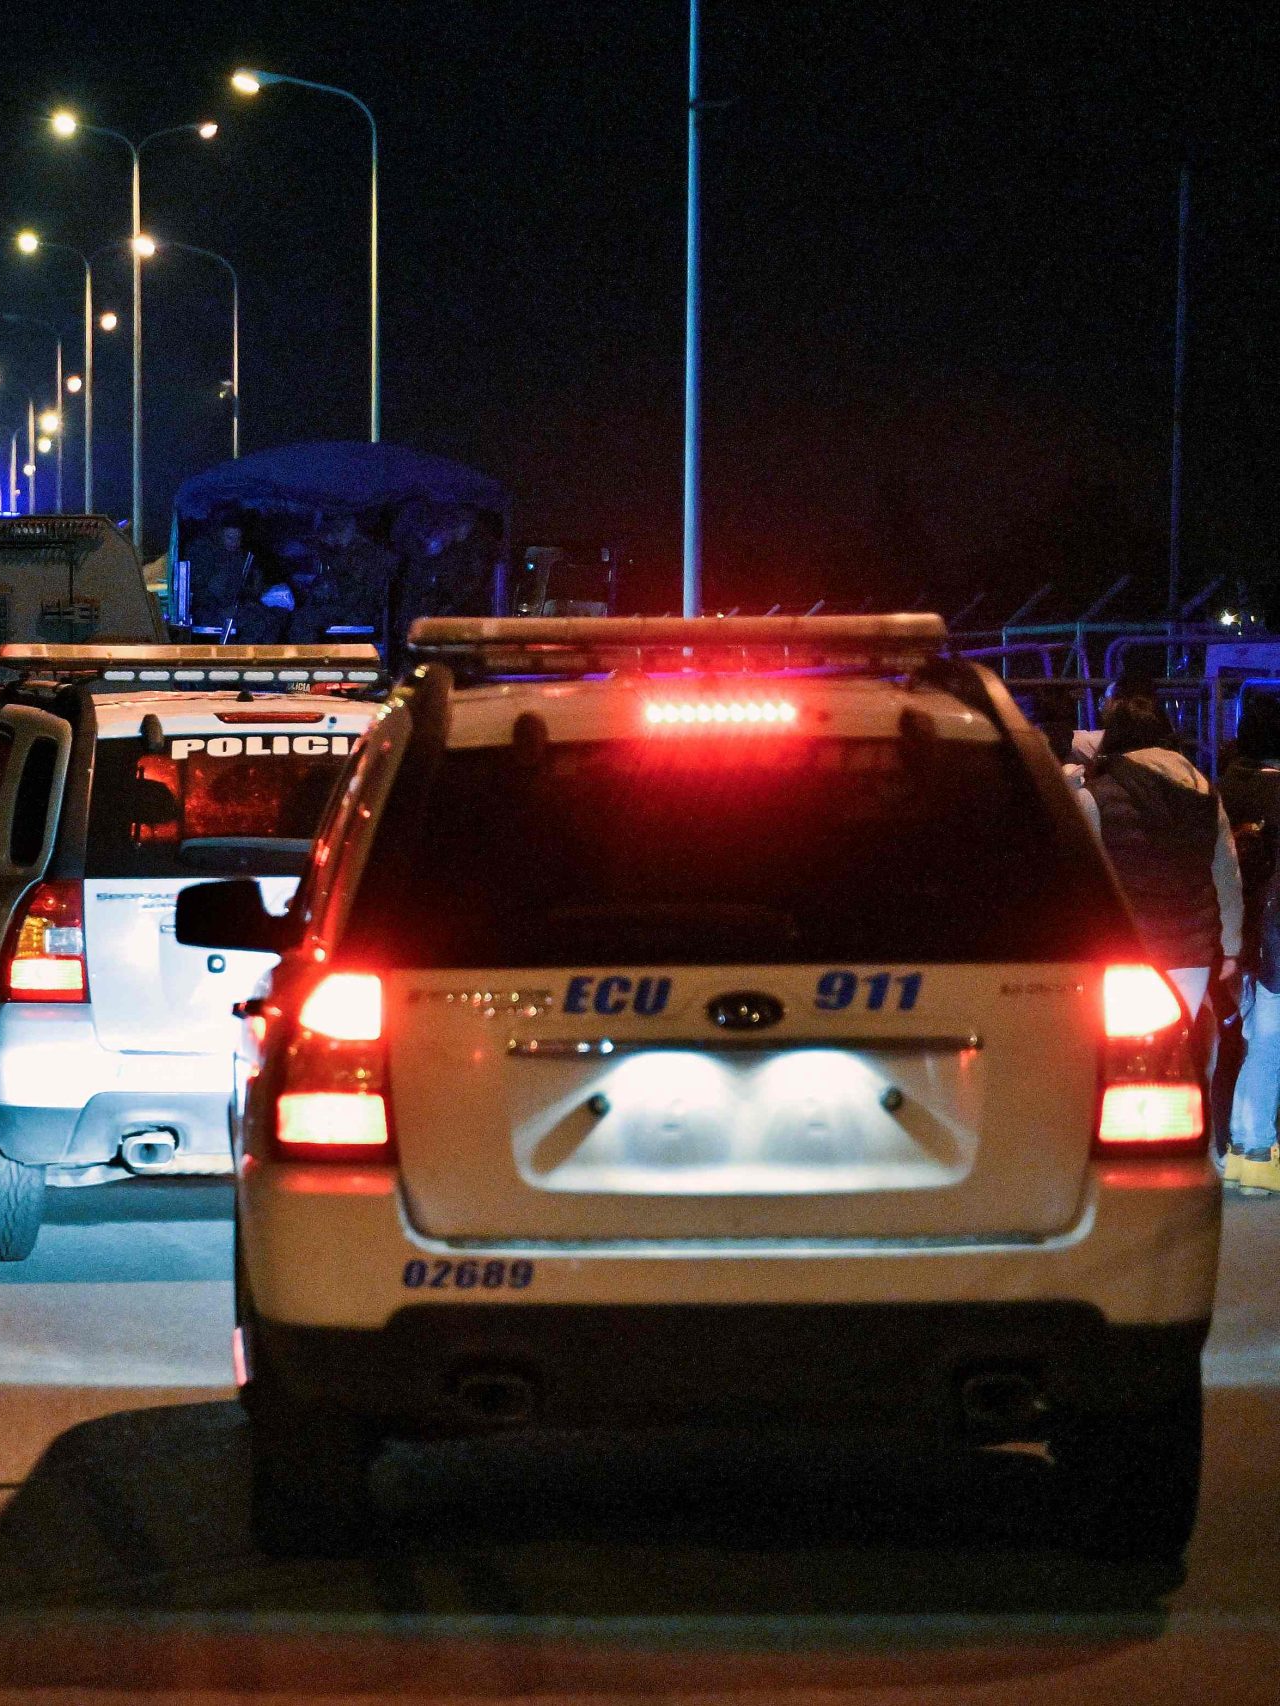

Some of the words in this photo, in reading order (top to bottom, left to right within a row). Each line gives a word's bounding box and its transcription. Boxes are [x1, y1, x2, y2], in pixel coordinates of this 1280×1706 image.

[563, 976, 672, 1016] ECU
[815, 970, 924, 1012] 911
[403, 1258, 534, 1290] 02689
